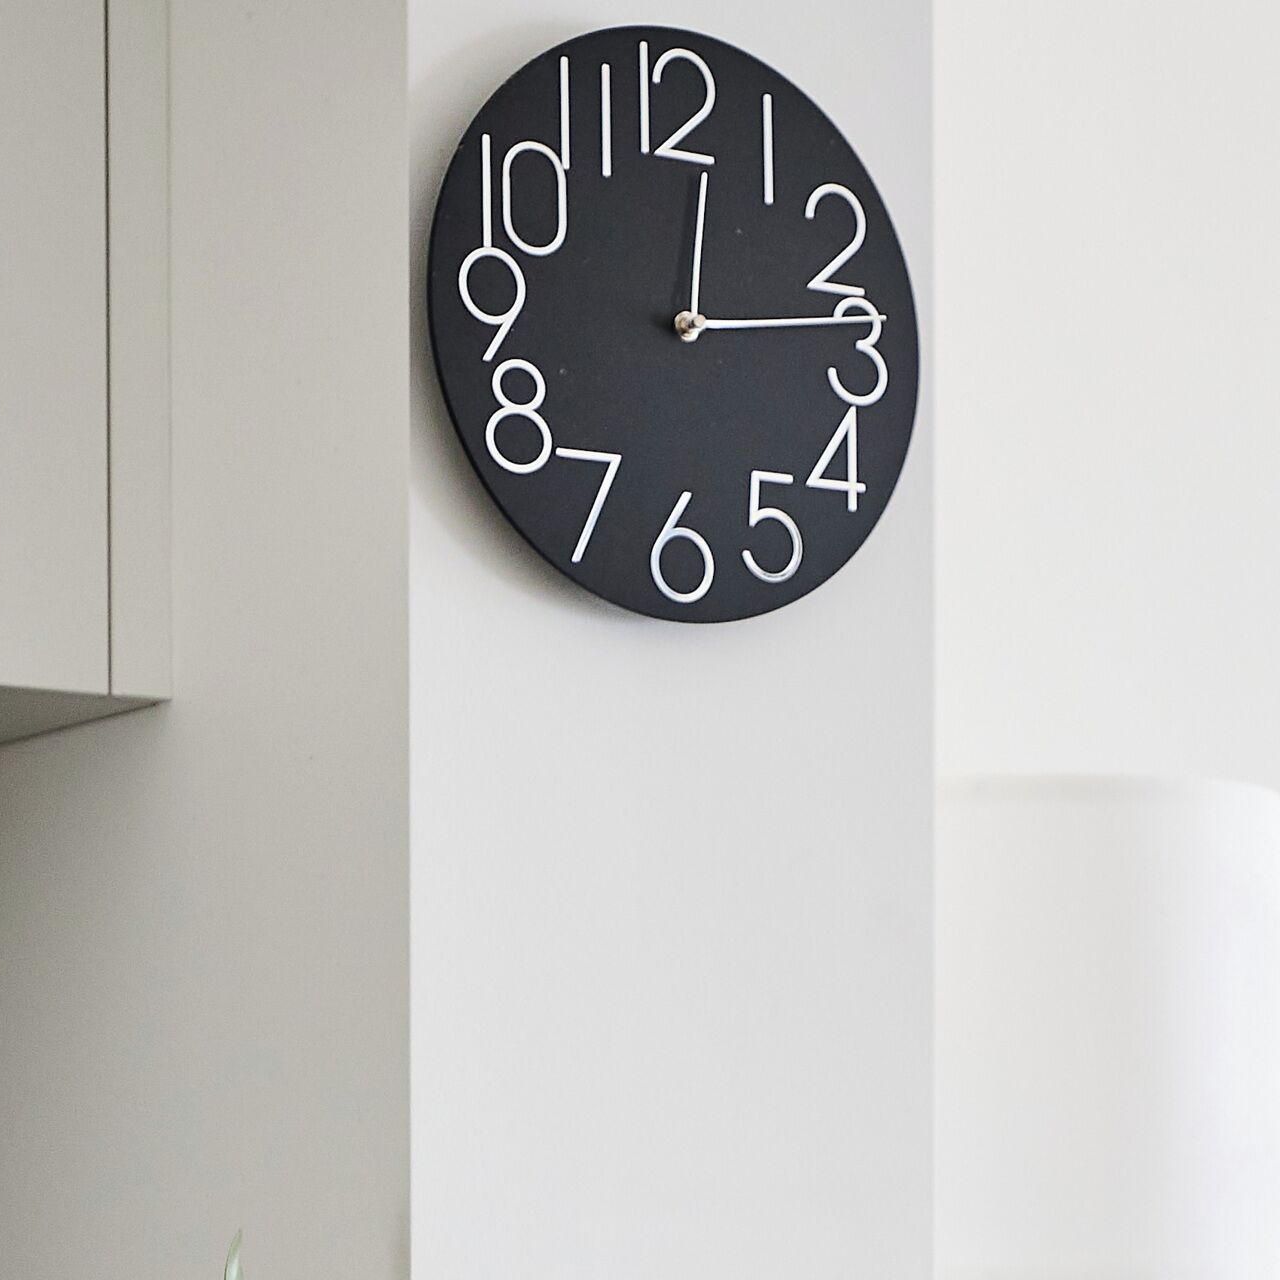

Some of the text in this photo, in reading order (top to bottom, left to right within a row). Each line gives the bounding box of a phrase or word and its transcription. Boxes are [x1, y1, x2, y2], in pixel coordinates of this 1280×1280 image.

[639, 40, 716, 165] 12
[761, 92, 774, 205] 1
[481, 133, 567, 257] 10
[804, 183, 867, 297] 2
[458, 246, 526, 362] 9
[828, 296, 888, 406] 3
[485, 358, 552, 474] 8
[805, 405, 866, 512] 4
[555, 447, 622, 562] 7
[650, 490, 715, 603] 6
[741, 470, 803, 583] 5
